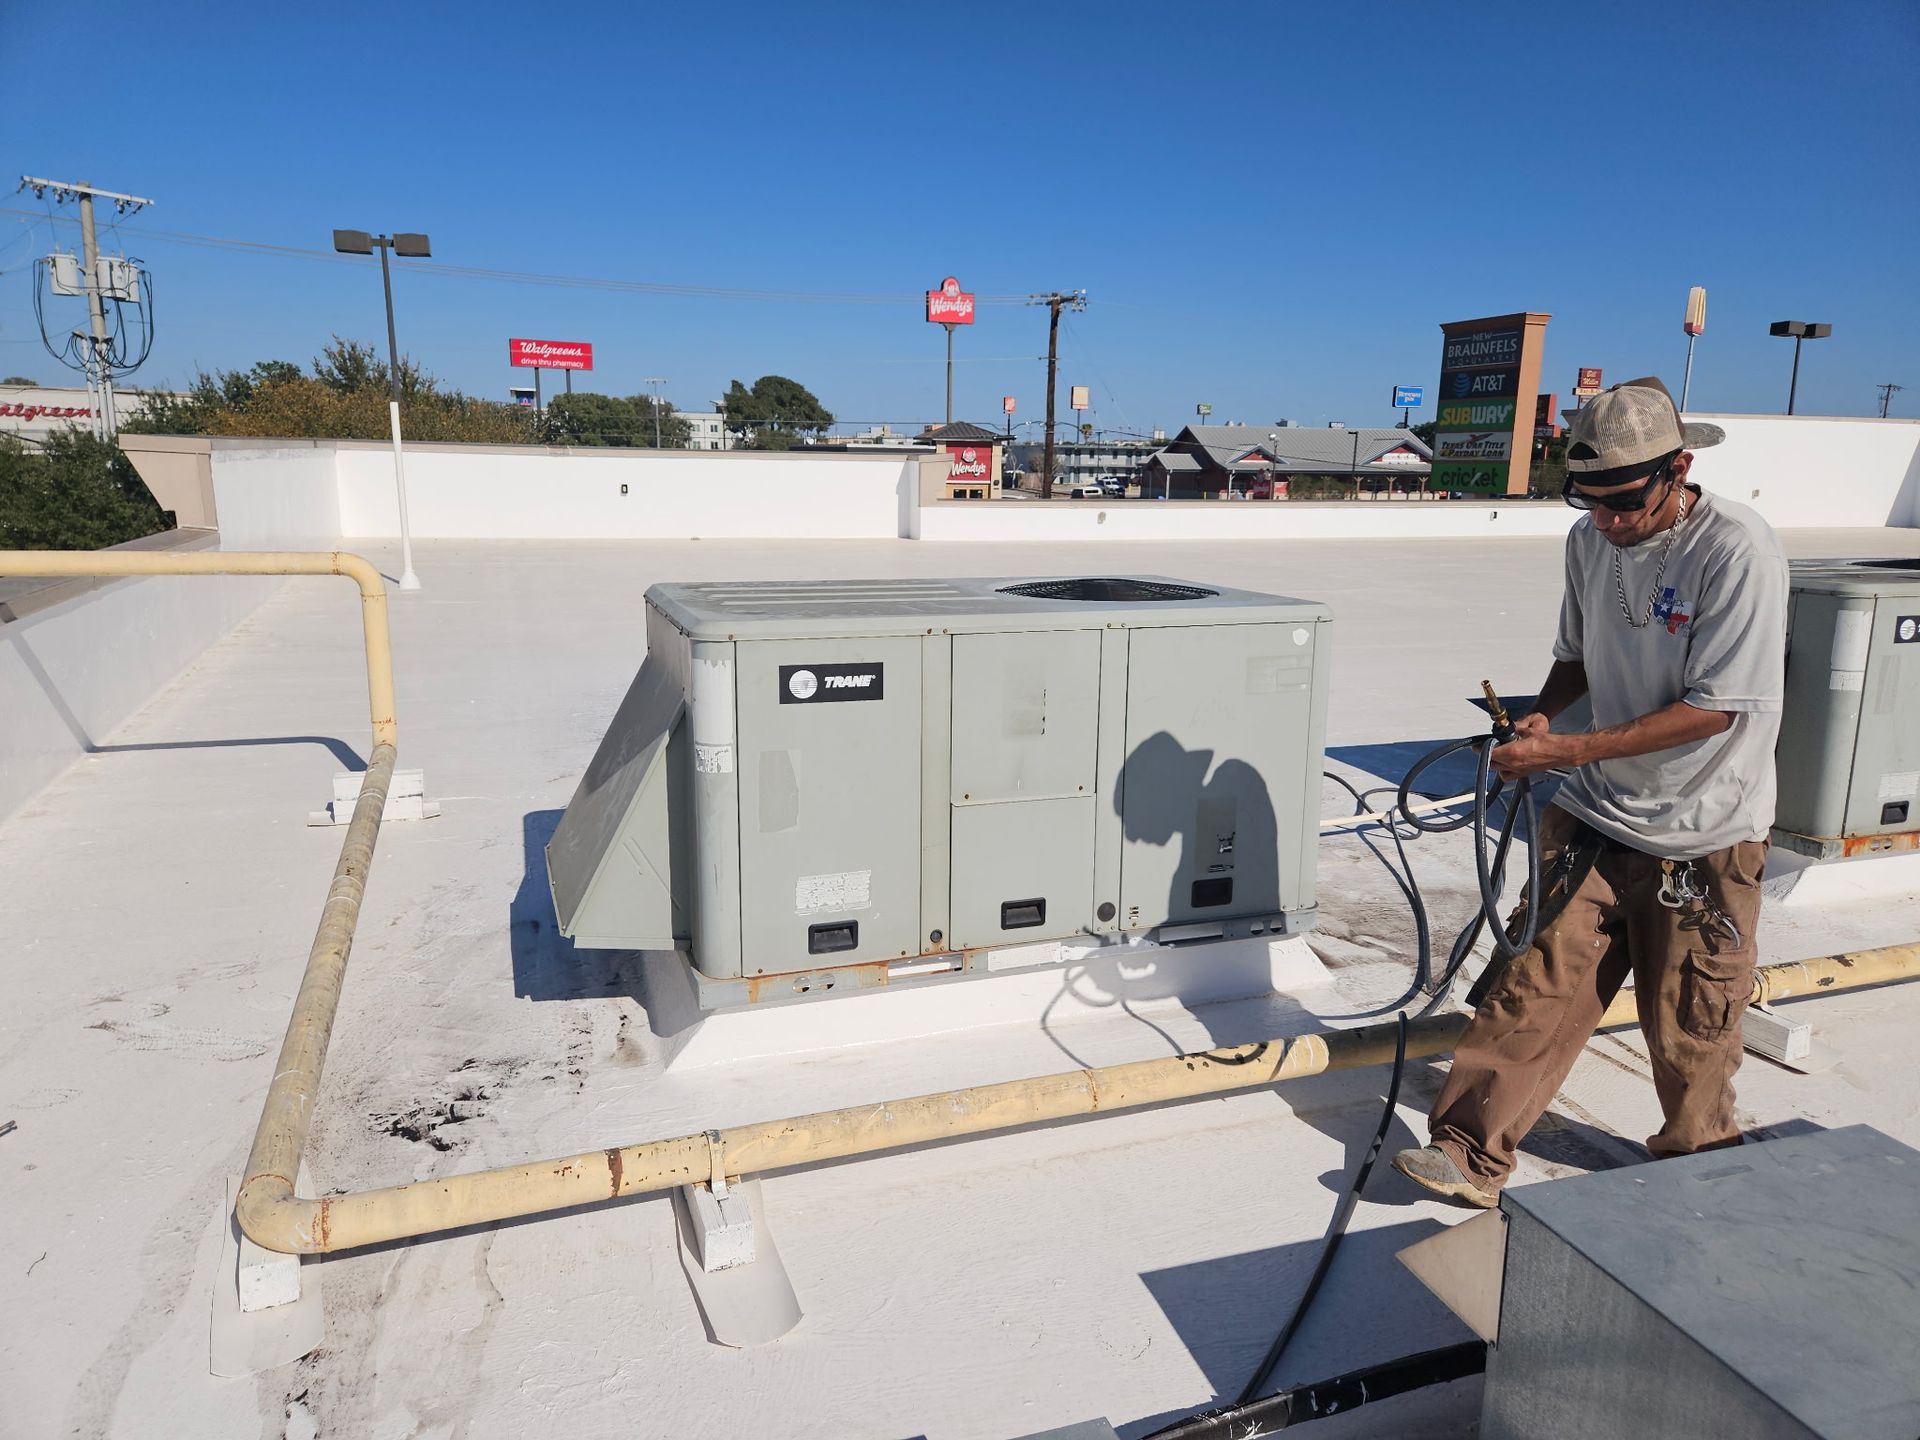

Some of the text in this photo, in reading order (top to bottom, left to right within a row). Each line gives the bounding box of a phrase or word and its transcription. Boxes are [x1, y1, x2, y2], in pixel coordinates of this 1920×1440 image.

[930, 296, 973, 317] Wendy's
[1472, 332, 1493, 341] NEW
[520, 342, 583, 357] Walgreens
[1447, 338, 1518, 358] BRAUNFELS
[552, 360, 584, 368] pharmacy
[1472, 374, 1506, 392] AT&T
[0, 403, 101, 421] algreen
[1439, 403, 1514, 426] SUBWAY
[951, 461, 986, 476] Wendy's
[1441, 467, 1498, 487] cricket
